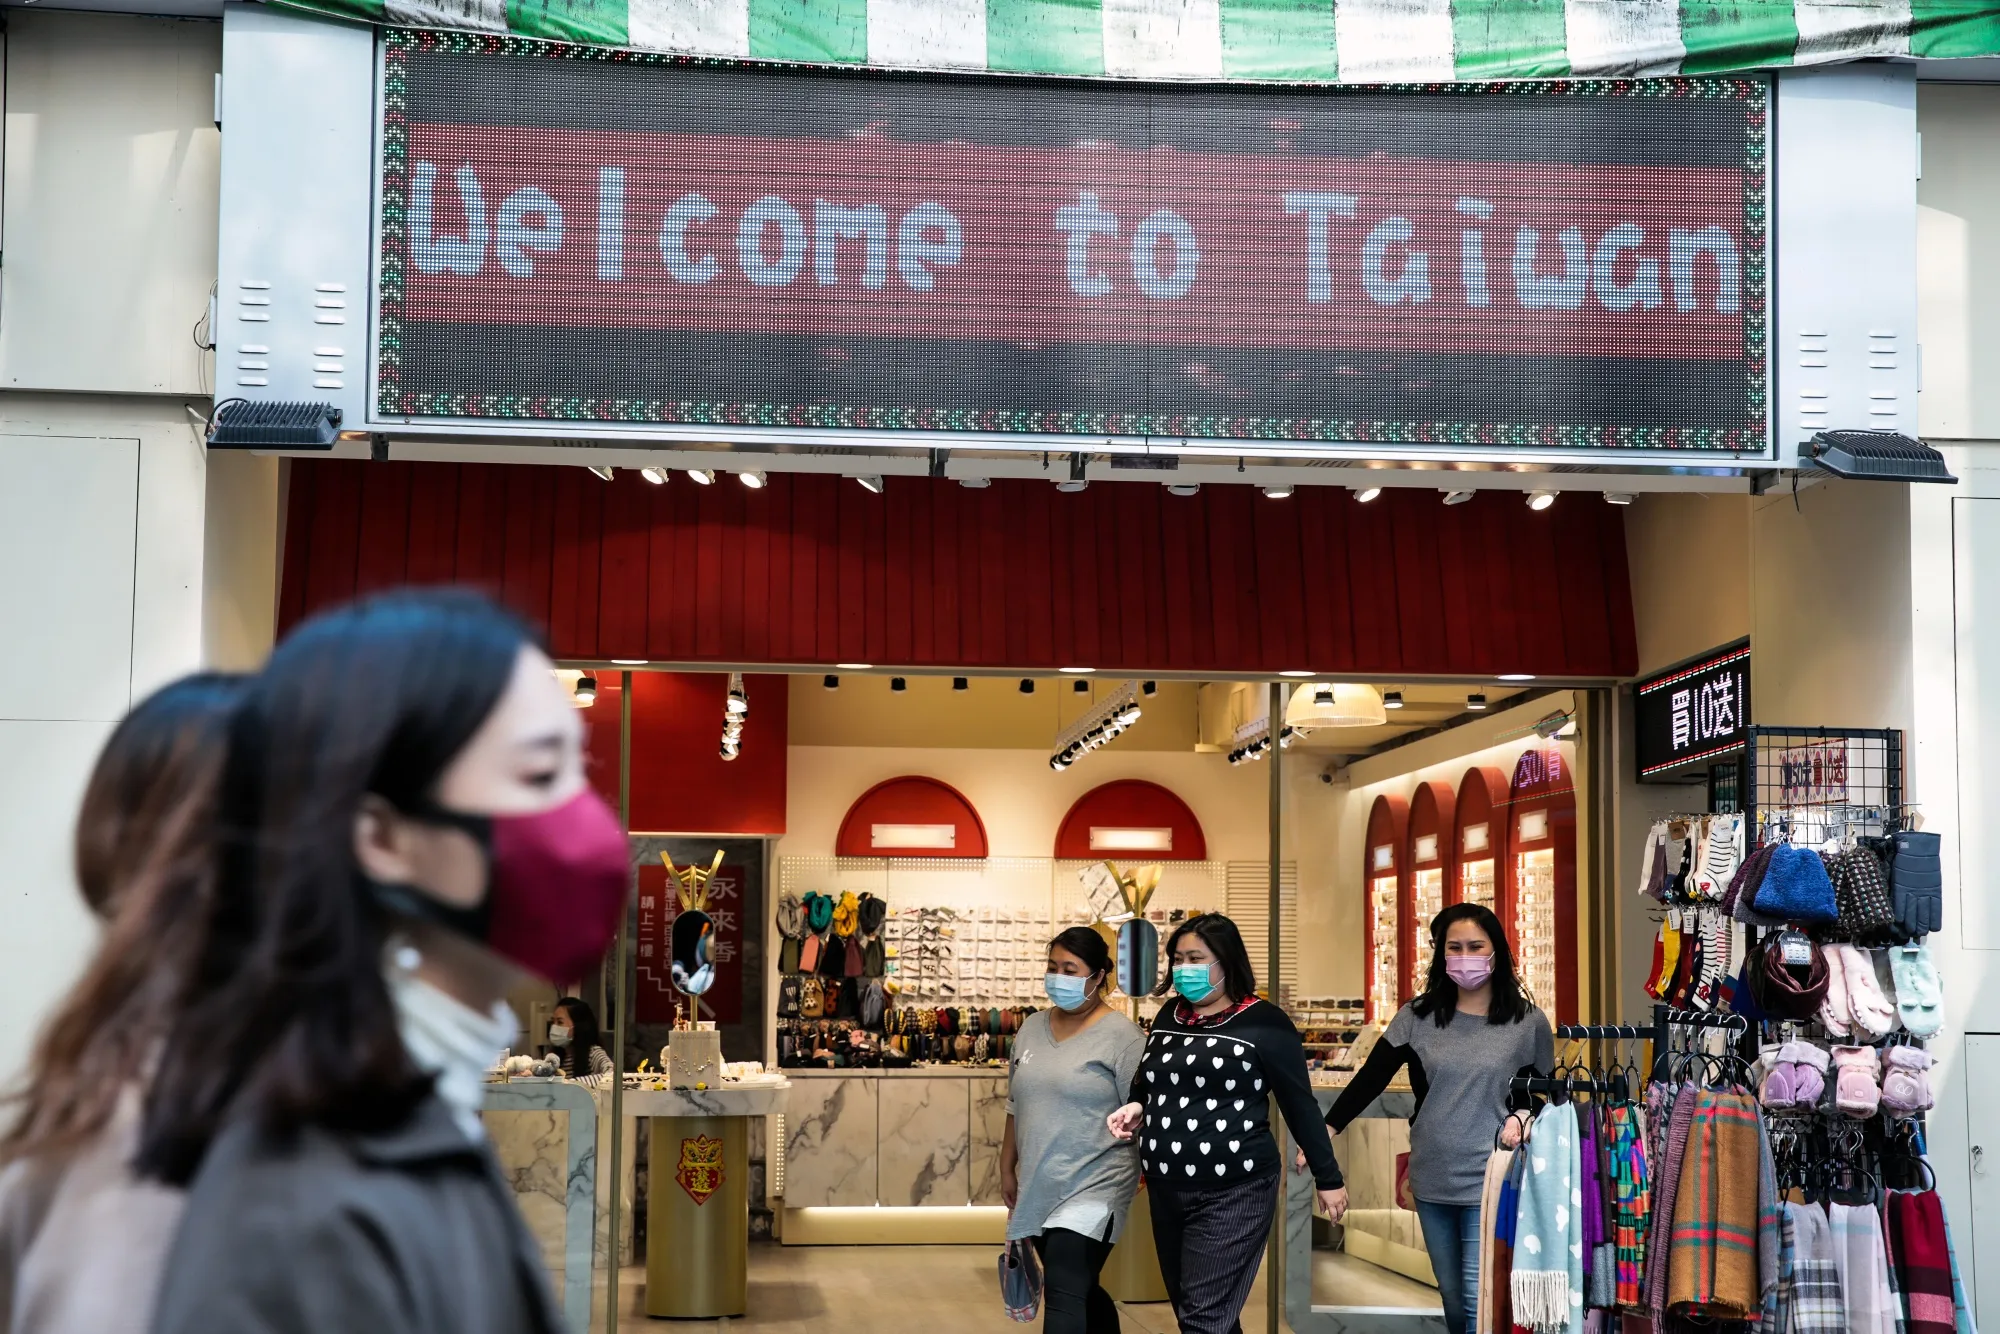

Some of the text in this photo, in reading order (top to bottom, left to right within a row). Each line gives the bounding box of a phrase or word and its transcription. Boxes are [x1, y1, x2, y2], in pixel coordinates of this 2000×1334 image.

[408, 159, 1740, 315] Welcome to Taiwan
[1672, 671, 1743, 750] 買10送1
